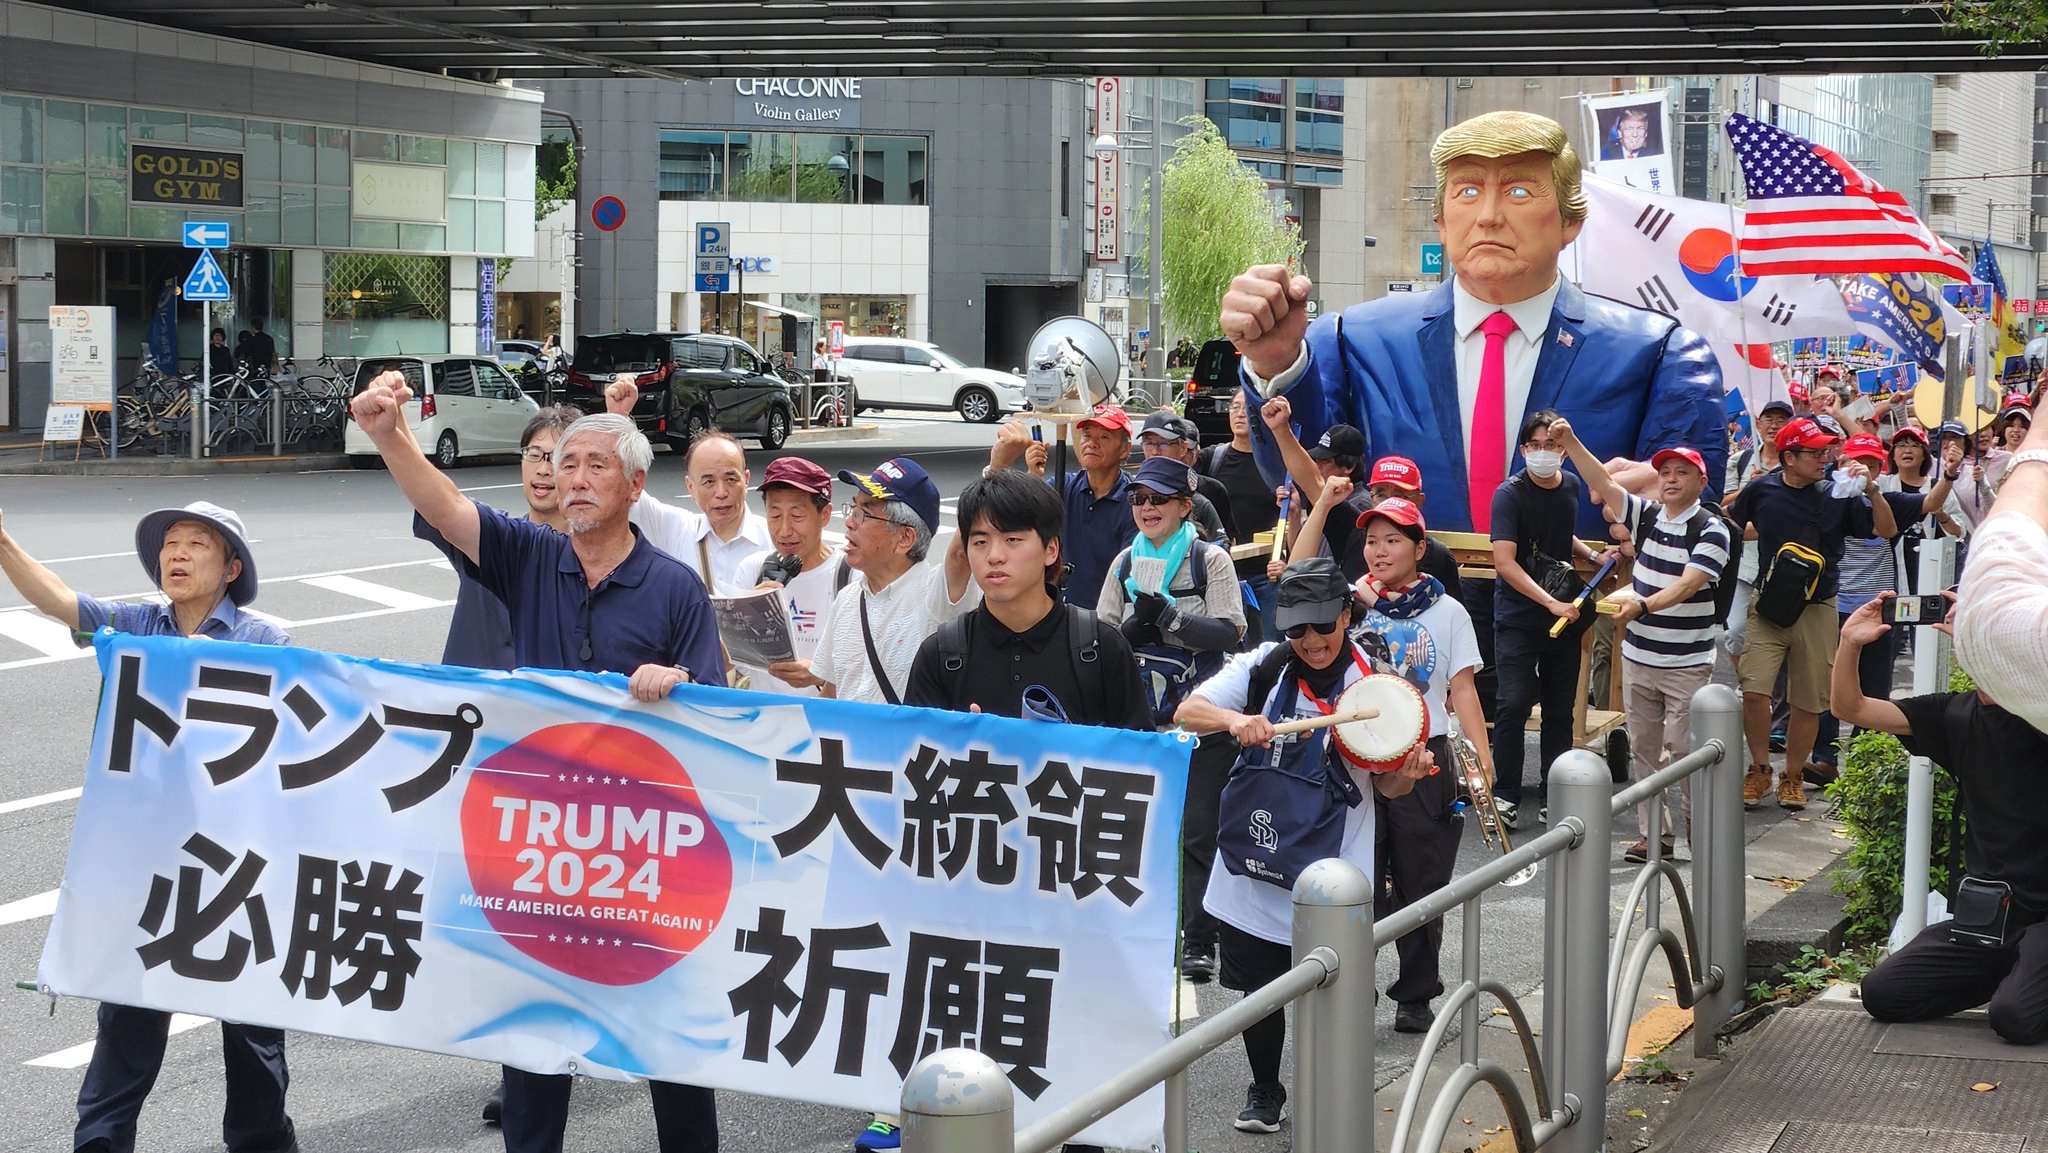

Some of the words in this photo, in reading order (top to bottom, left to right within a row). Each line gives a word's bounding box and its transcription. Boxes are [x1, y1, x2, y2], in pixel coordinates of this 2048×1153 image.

[735, 78, 862, 99] CHACONNE
[754, 102, 791, 120] Violin
[795, 108, 842, 121] Gallery
[133, 153, 240, 180] GOLD'S
[153, 178, 222, 201] GYM
[1648, 168, 1661, 193] 世界
[700, 227, 721, 253] P
[709, 245, 727, 253] 24H
[700, 261, 725, 271] 銀座
[481, 264, 494, 352] 営業中
[1840, 280, 1879, 300] TAKE
[1879, 295, 1925, 347] AMERICA
[1380, 462, 1410, 474] Trump
[108, 655, 484, 813] トランプ
[773, 737, 1155, 907] 大統領
[492, 796, 706, 858] TRUMP
[512, 847, 662, 903] 2024
[459, 893, 505, 911] MAKE
[506, 899, 586, 918] AMERICA
[590, 905, 649, 923] GREAT
[651, 911, 703, 931] AGAIN
[135, 832, 425, 1012] 必勝
[727, 906, 1061, 1101] 祈願
